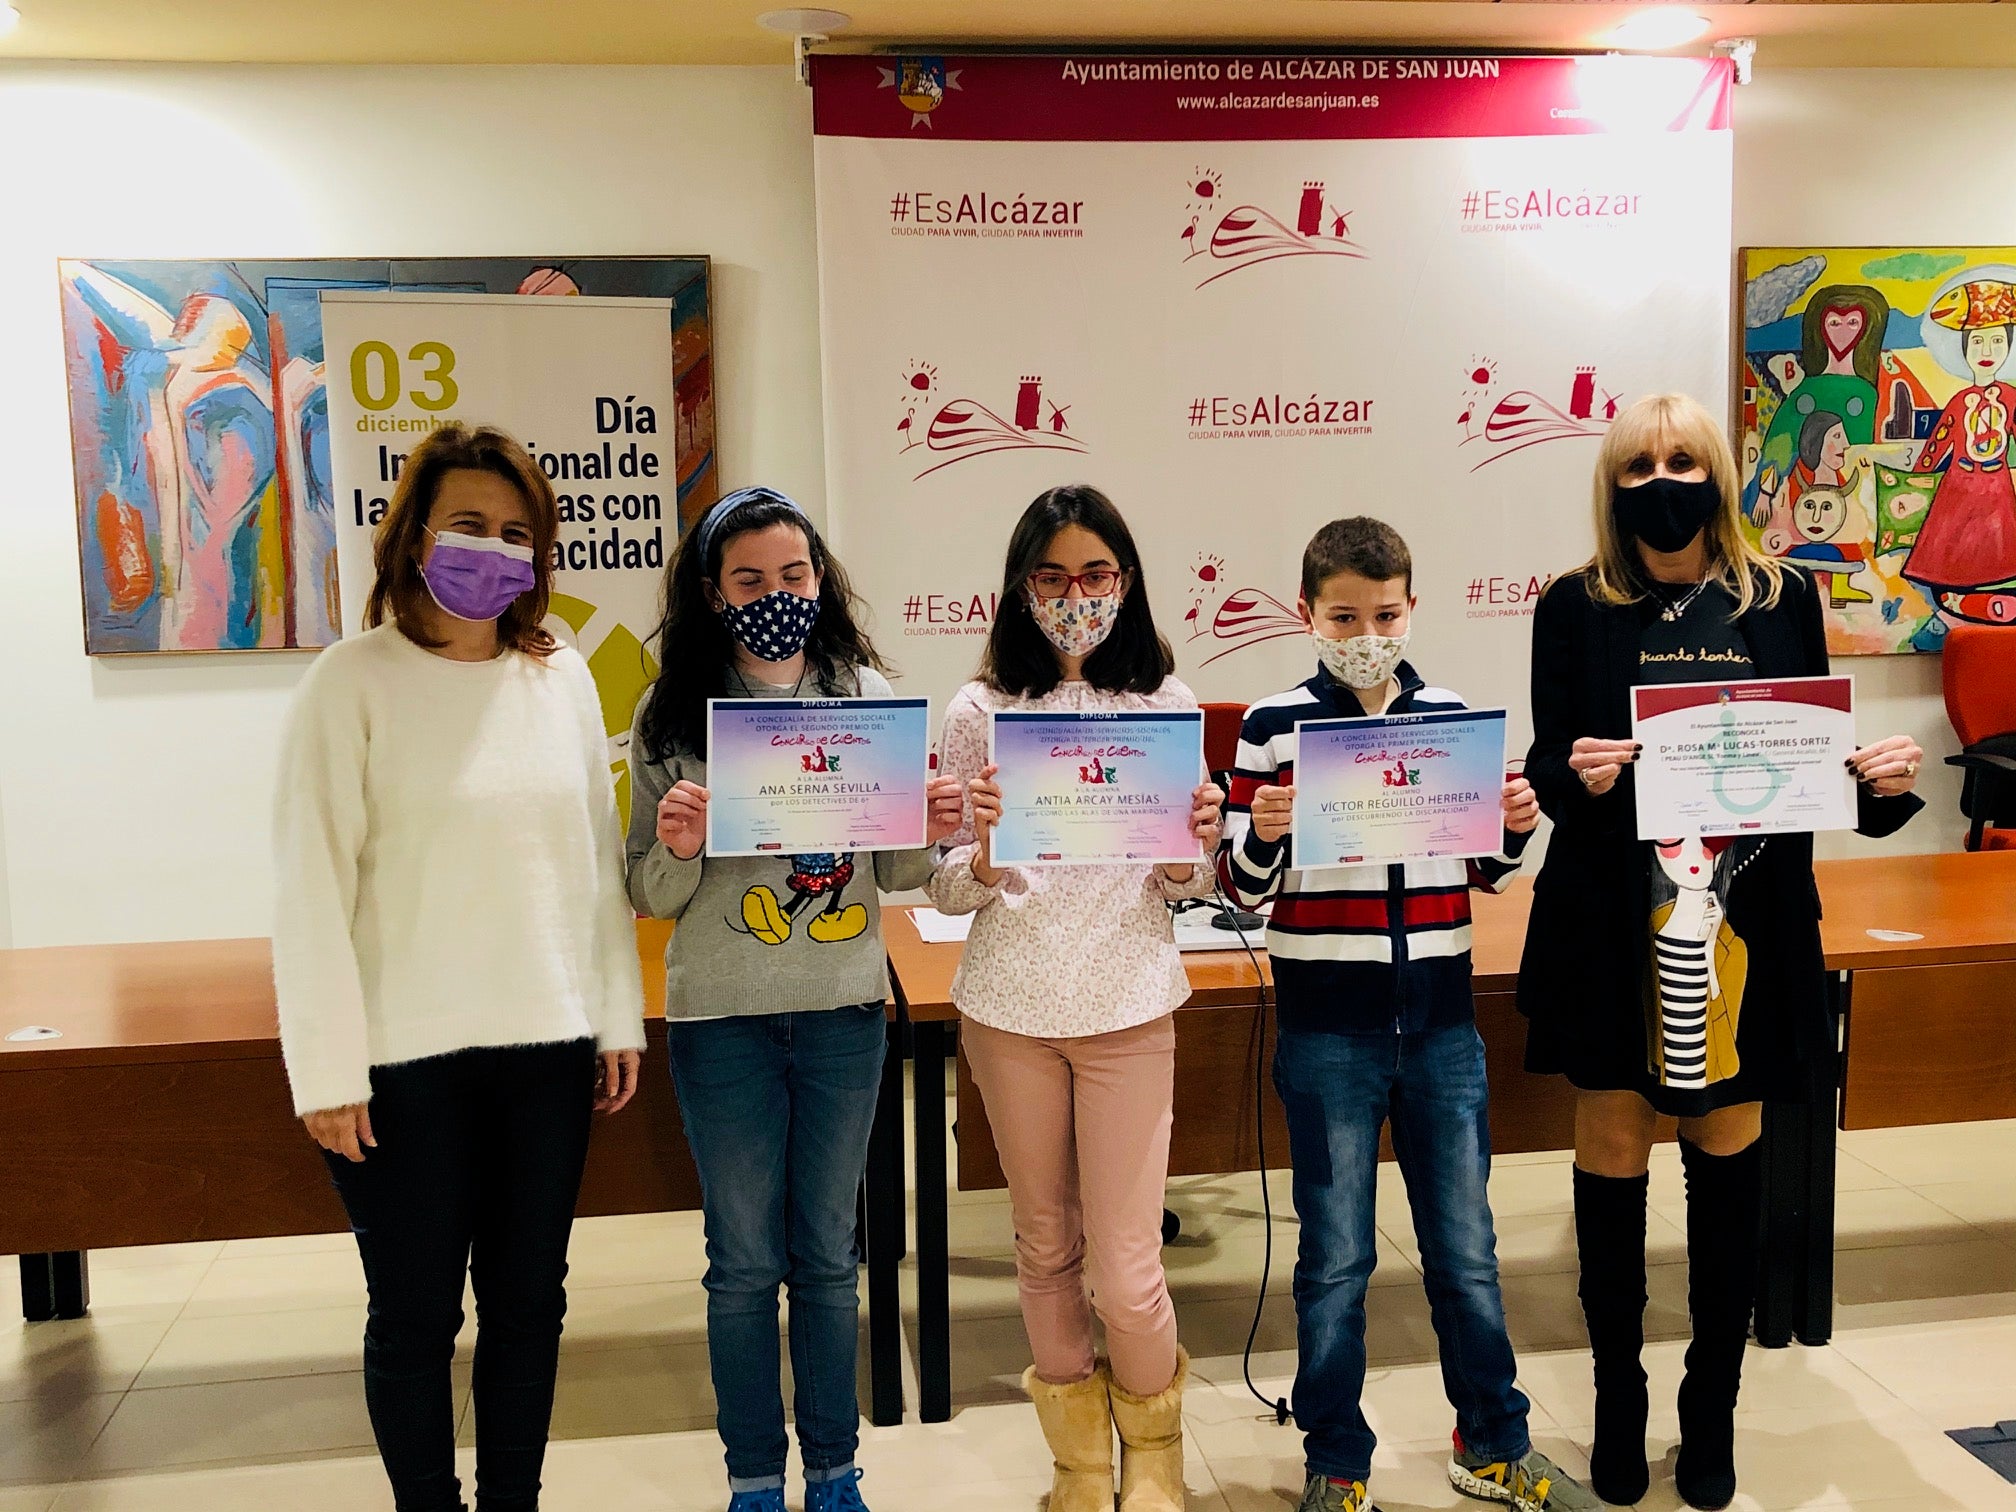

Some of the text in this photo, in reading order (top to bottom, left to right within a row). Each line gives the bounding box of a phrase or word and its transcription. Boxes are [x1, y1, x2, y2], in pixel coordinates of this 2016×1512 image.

[1062, 57, 1500, 84] Ayuntamiento de ALCÁZAR DE SAN JUAN
[1177, 91, 1379, 111] www.alcazardesanjuan.es
[890, 192, 1083, 224] #EsAlcázar
[1461, 188, 1642, 220] #EsAlcázar
[891, 227, 1083, 238] CIUDAD PARA VIVIR, CIUDAD PARA INVERTIR
[350, 340, 459, 411] 03
[1784, 360, 1796, 380] B
[595, 395, 657, 434] Día
[1188, 394, 1373, 426] #EsAlcázar
[1188, 427, 1372, 440] CIUDAD PARA VIVIR, CIUDAD PARA INVERTIR
[617, 443, 659, 478] de
[602, 493, 661, 520] con
[1467, 610, 1496, 618] CIUDAD
[904, 628, 936, 636] CIUDAD
[939, 627, 961, 635] PARA
[757, 715, 805, 723] CONCEJALÍA
[1384, 717, 1424, 725] DIPLOMA
[756, 724, 787, 732] OTORGA
[1342, 733, 1387, 742] CONCEJALÍA
[1401, 730, 1439, 738] SERVICIOS
[1441, 727, 1475, 735] SOCIALES
[1345, 742, 1375, 750] OTORGA
[1388, 739, 1415, 747] PRIMER
[1677, 743, 1705, 752] ROSA
[1800, 736, 1831, 746] ORTIZ
[759, 782, 881, 795] ANA SERNA SEVILLA
[1392, 788, 1420, 796] ALUMNO
[802, 797, 847, 805] DETECTIVES
[1035, 793, 1160, 806] ANTIA ARCAY MESÍAS
[1320, 791, 1480, 813] VÍCTOR REGUILLO HERRERA
[1346, 812, 1402, 822] DESCUBRIENDO
[1416, 806, 1469, 816] DISCAPACIDAD
